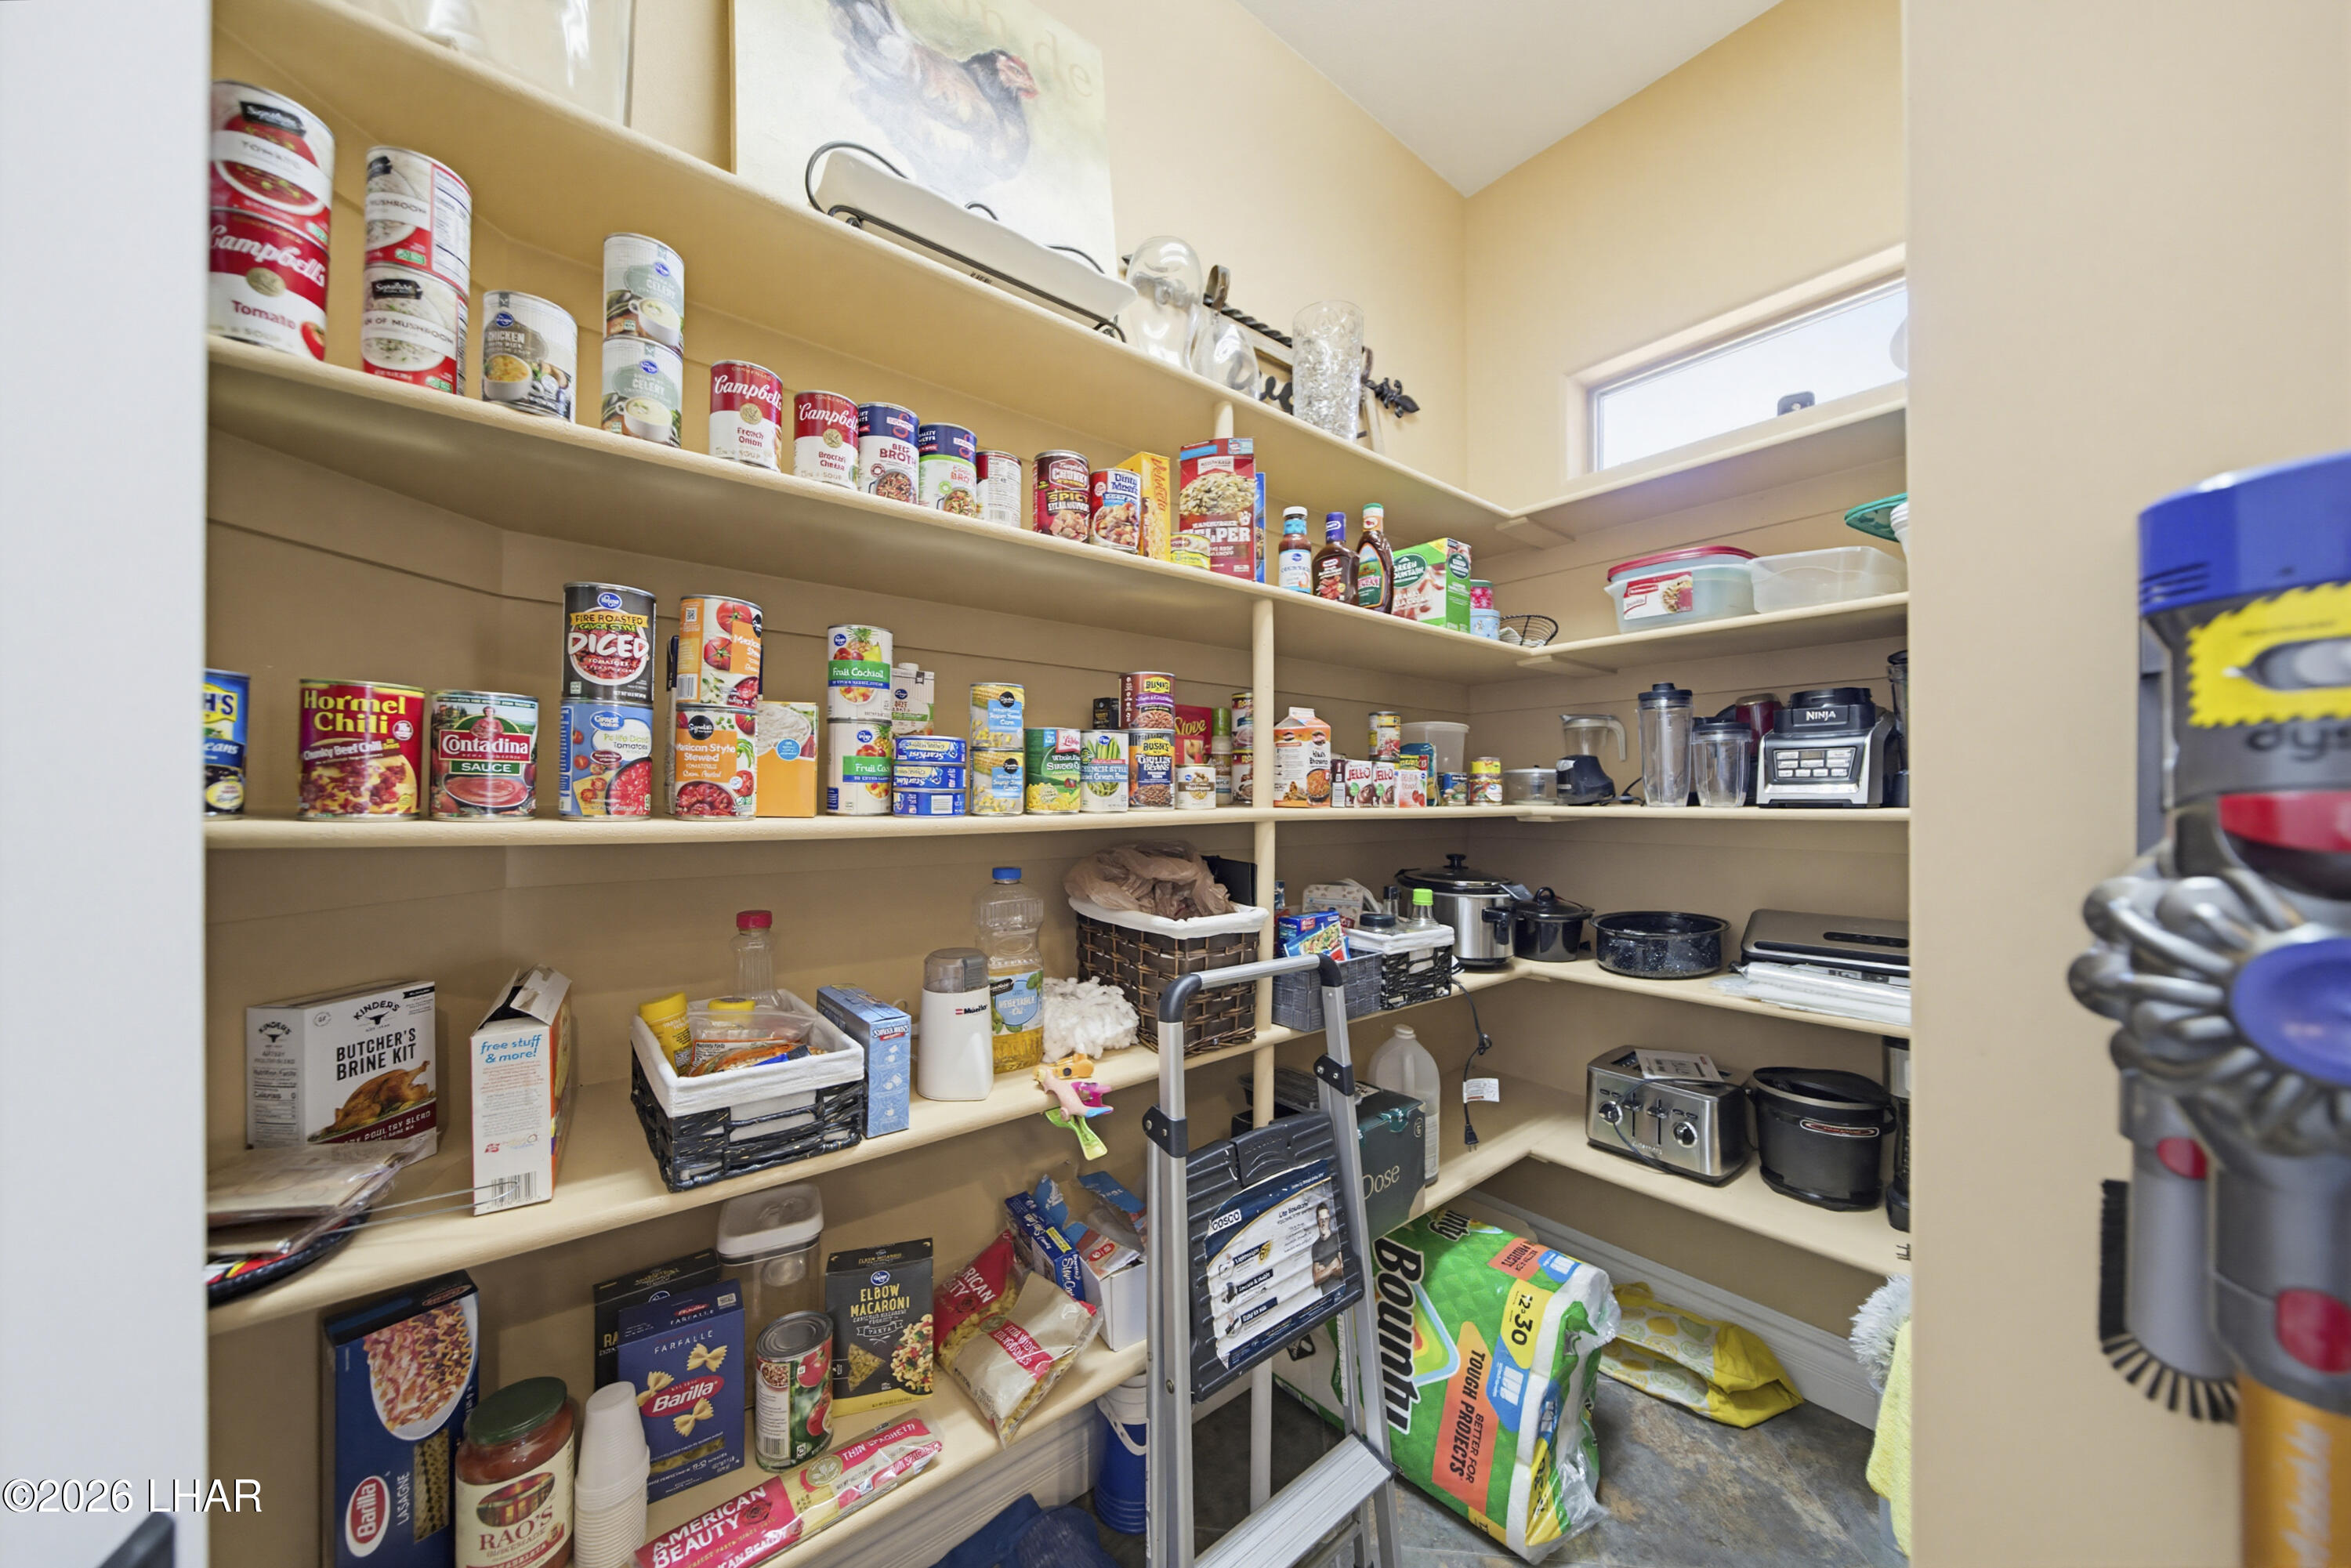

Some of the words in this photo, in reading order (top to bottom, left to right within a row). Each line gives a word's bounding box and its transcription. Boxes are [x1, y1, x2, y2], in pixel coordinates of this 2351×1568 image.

[231, 299, 296, 330] Tomato
[392, 319, 454, 346] MUSHROOM
[487, 331, 526, 345] CHICKEN
[632, 378, 665, 396] CELERY
[737, 426, 764, 440] French
[738, 436, 763, 448] Onion
[879, 447, 917, 468] BROTH
[575, 614, 596, 623] FIRE
[597, 614, 643, 625] ROASTED
[567, 632, 650, 659] DICED
[832, 666, 850, 677] Fruit
[850, 667, 884, 679] Cocktail
[304, 690, 406, 715] Hormel
[313, 712, 389, 734] Chili
[1176, 717, 1207, 736] Stove
[1805, 710, 1837, 722] NINJA
[442, 733, 529, 755] Contadina
[709, 742, 736, 754] Style
[461, 762, 513, 773] SAUCE
[683, 751, 720, 762] Stewed
[855, 762, 876, 773] Fruit
[335, 1027, 417, 1063] BUTCHER'S
[480, 1040, 508, 1056] free
[511, 1034, 542, 1049] stuff
[485, 1053, 498, 1064] &
[498, 1044, 539, 1063] more!
[335, 1051, 387, 1081] BRINE
[392, 1042, 417, 1065] KIT
[1212, 1211, 1241, 1231] COSCO
[860, 1283, 900, 1302] ELBOW
[849, 1295, 911, 1319] MACARONI
[1373, 1237, 1423, 1434] Bounty
[1511, 1313, 1534, 1346] 30
[654, 1330, 715, 1355] FARFALLE
[1462, 1349, 1486, 1403] TOUGH
[652, 1381, 716, 1414] Barilla
[1449, 1400, 1476, 1479] PROJECTS
[1469, 1413, 1485, 1457] BETTER
[842, 1443, 867, 1462] THIN
[1465, 1457, 1477, 1485] FOR
[357, 1481, 377, 1538] Barilla
[397, 1470, 411, 1526] LASAGNE
[479, 1505, 553, 1552] RAO'S
[653, 1487, 767, 1555] AMERICAN
[653, 1512, 741, 1568] BEAUTY
